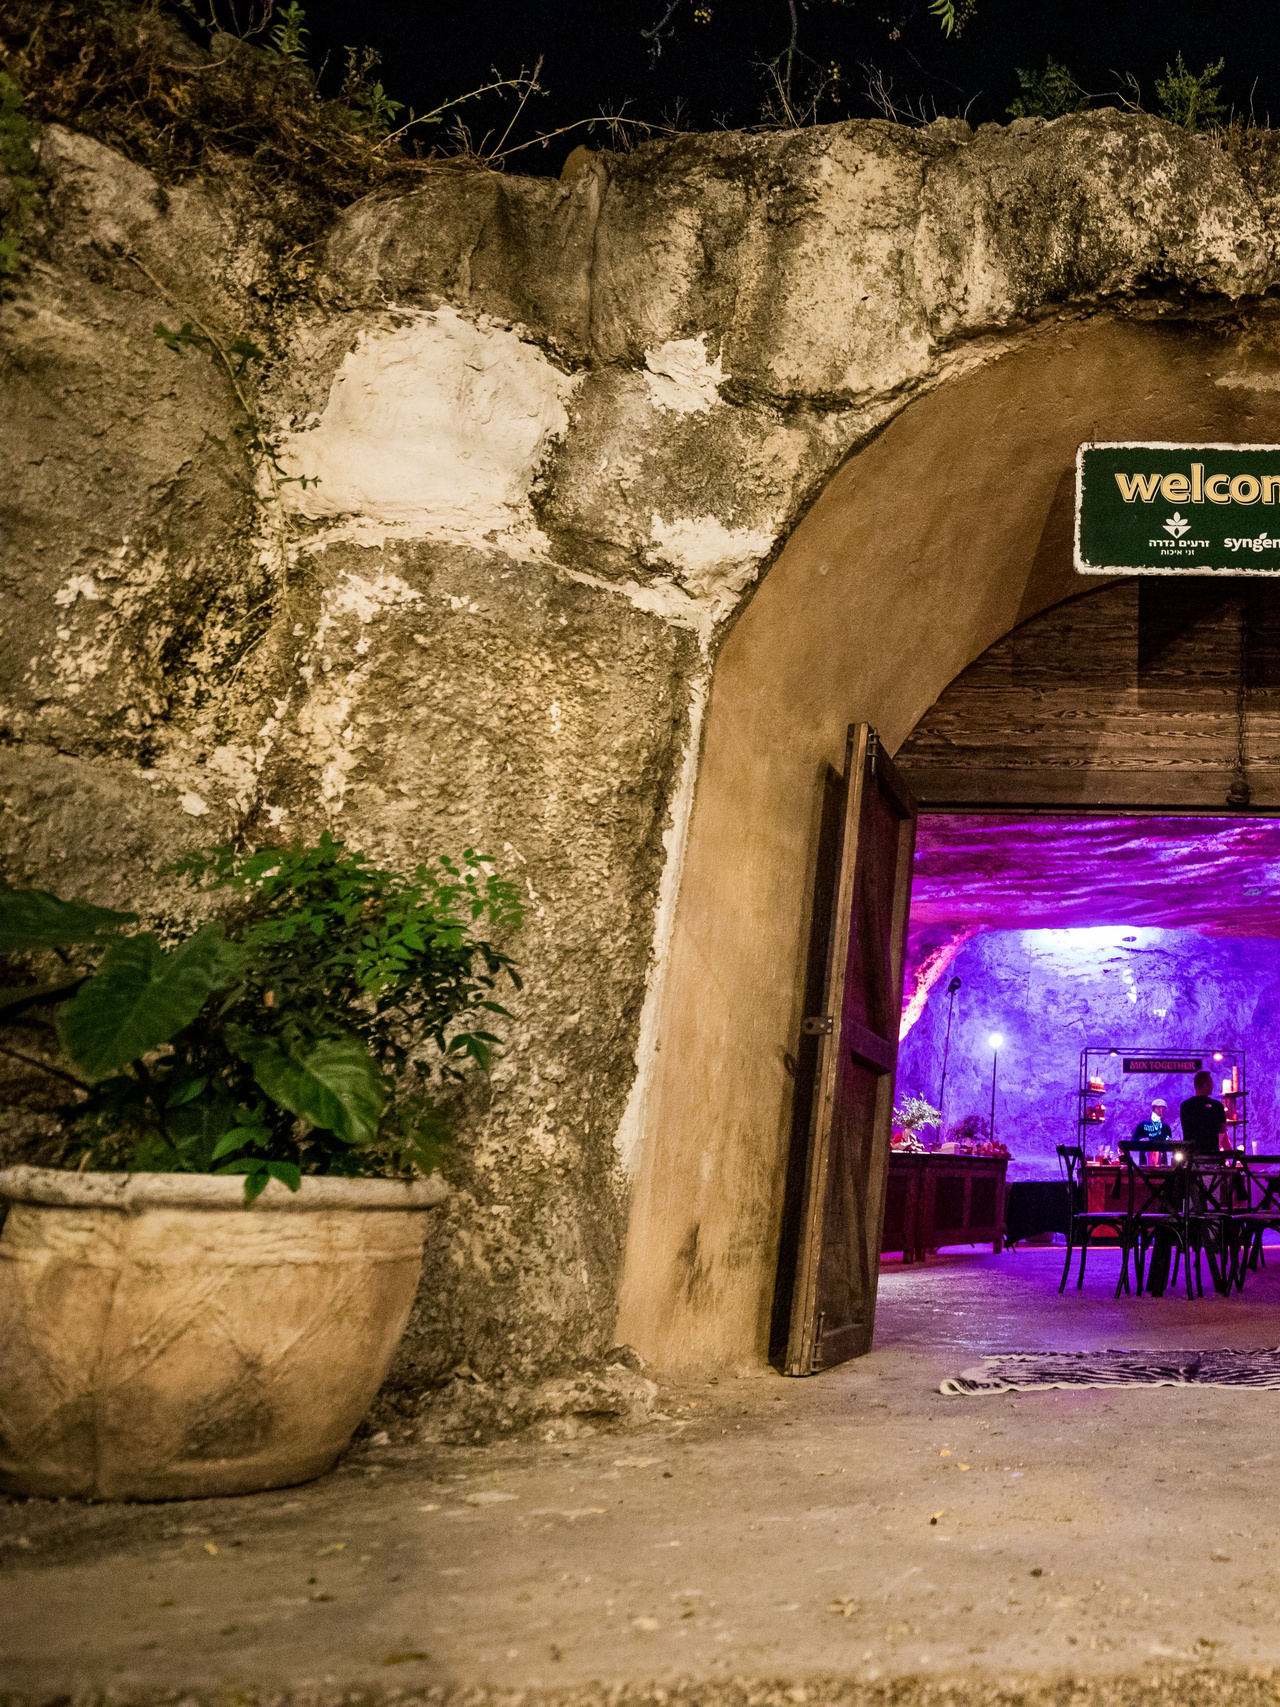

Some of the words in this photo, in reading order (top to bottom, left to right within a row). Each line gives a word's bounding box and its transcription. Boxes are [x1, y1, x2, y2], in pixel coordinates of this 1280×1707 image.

[1148, 539, 1176, 548] גדרה
[1178, 539, 1210, 548] זרעים
[1129, 1061, 1147, 1070] MIX
[1149, 1061, 1195, 1070] TOGETHER
